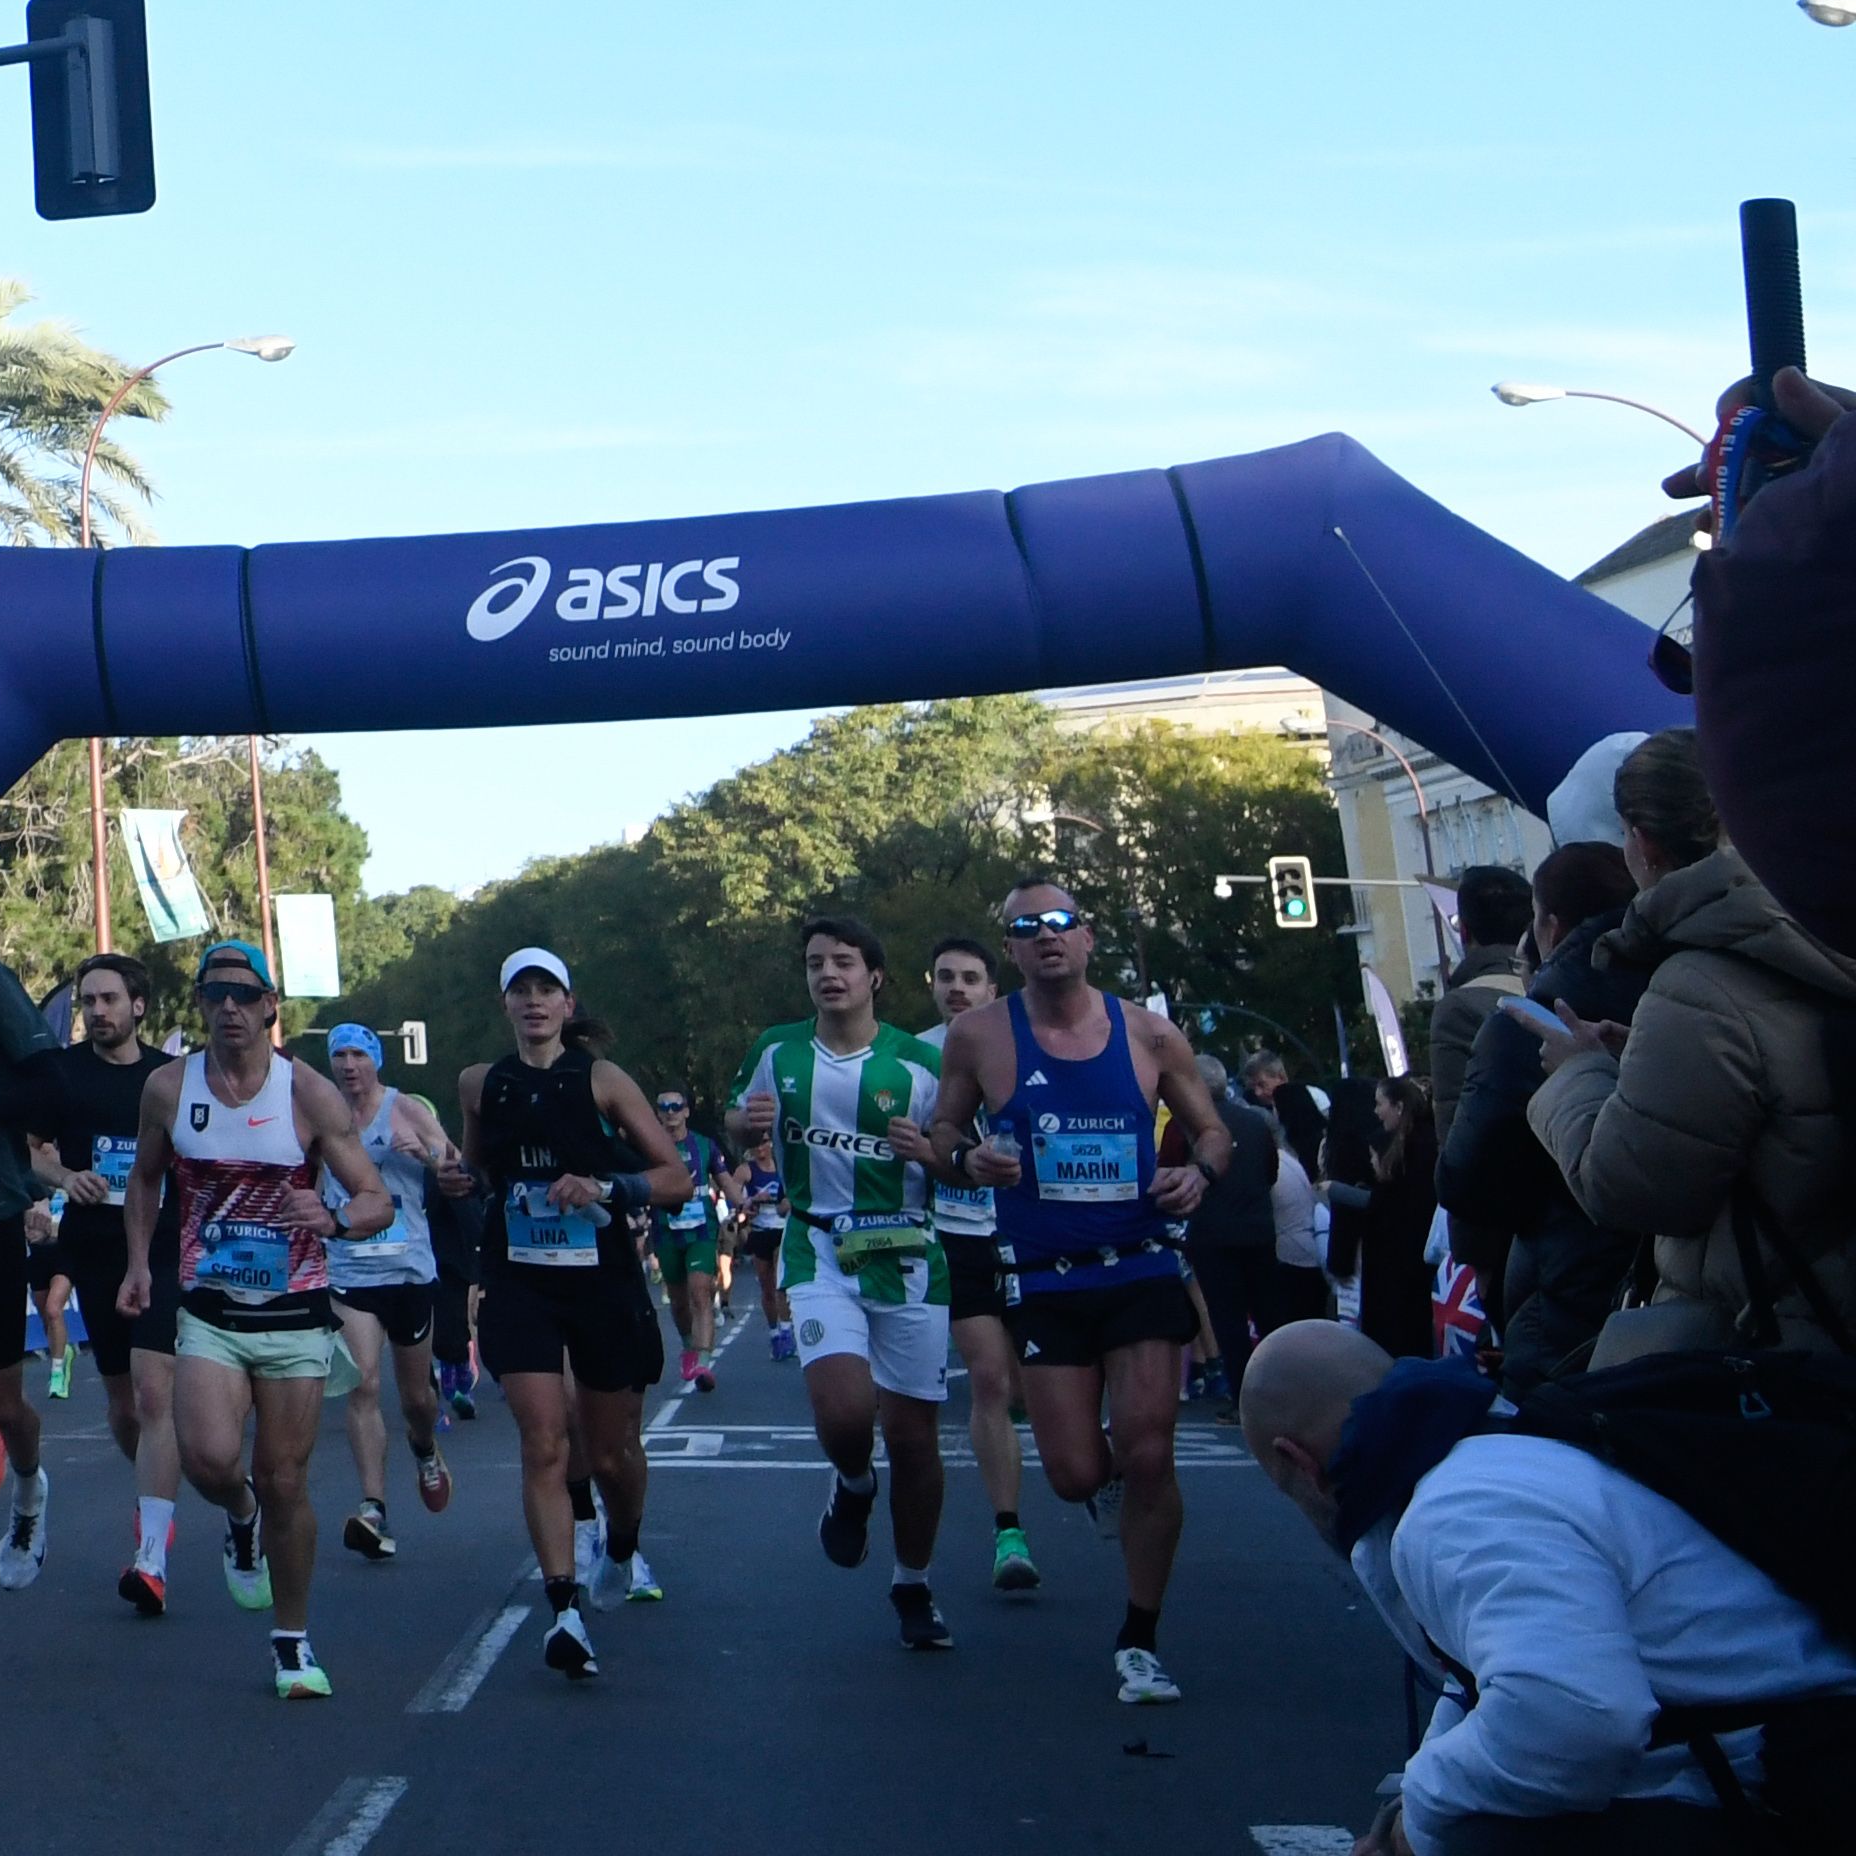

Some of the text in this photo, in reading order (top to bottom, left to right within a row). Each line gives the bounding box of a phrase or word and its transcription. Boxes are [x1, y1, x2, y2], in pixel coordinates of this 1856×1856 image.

[556, 556, 740, 621] asics
[548, 627, 791, 663] sound mind, sound body
[1067, 1117, 1125, 1130] ZURICH
[1056, 1158, 1120, 1180] MARÍN
[858, 1214, 909, 1228] ZURICH
[225, 1224, 278, 1241] ZURICH
[530, 1228, 569, 1245] LINA
